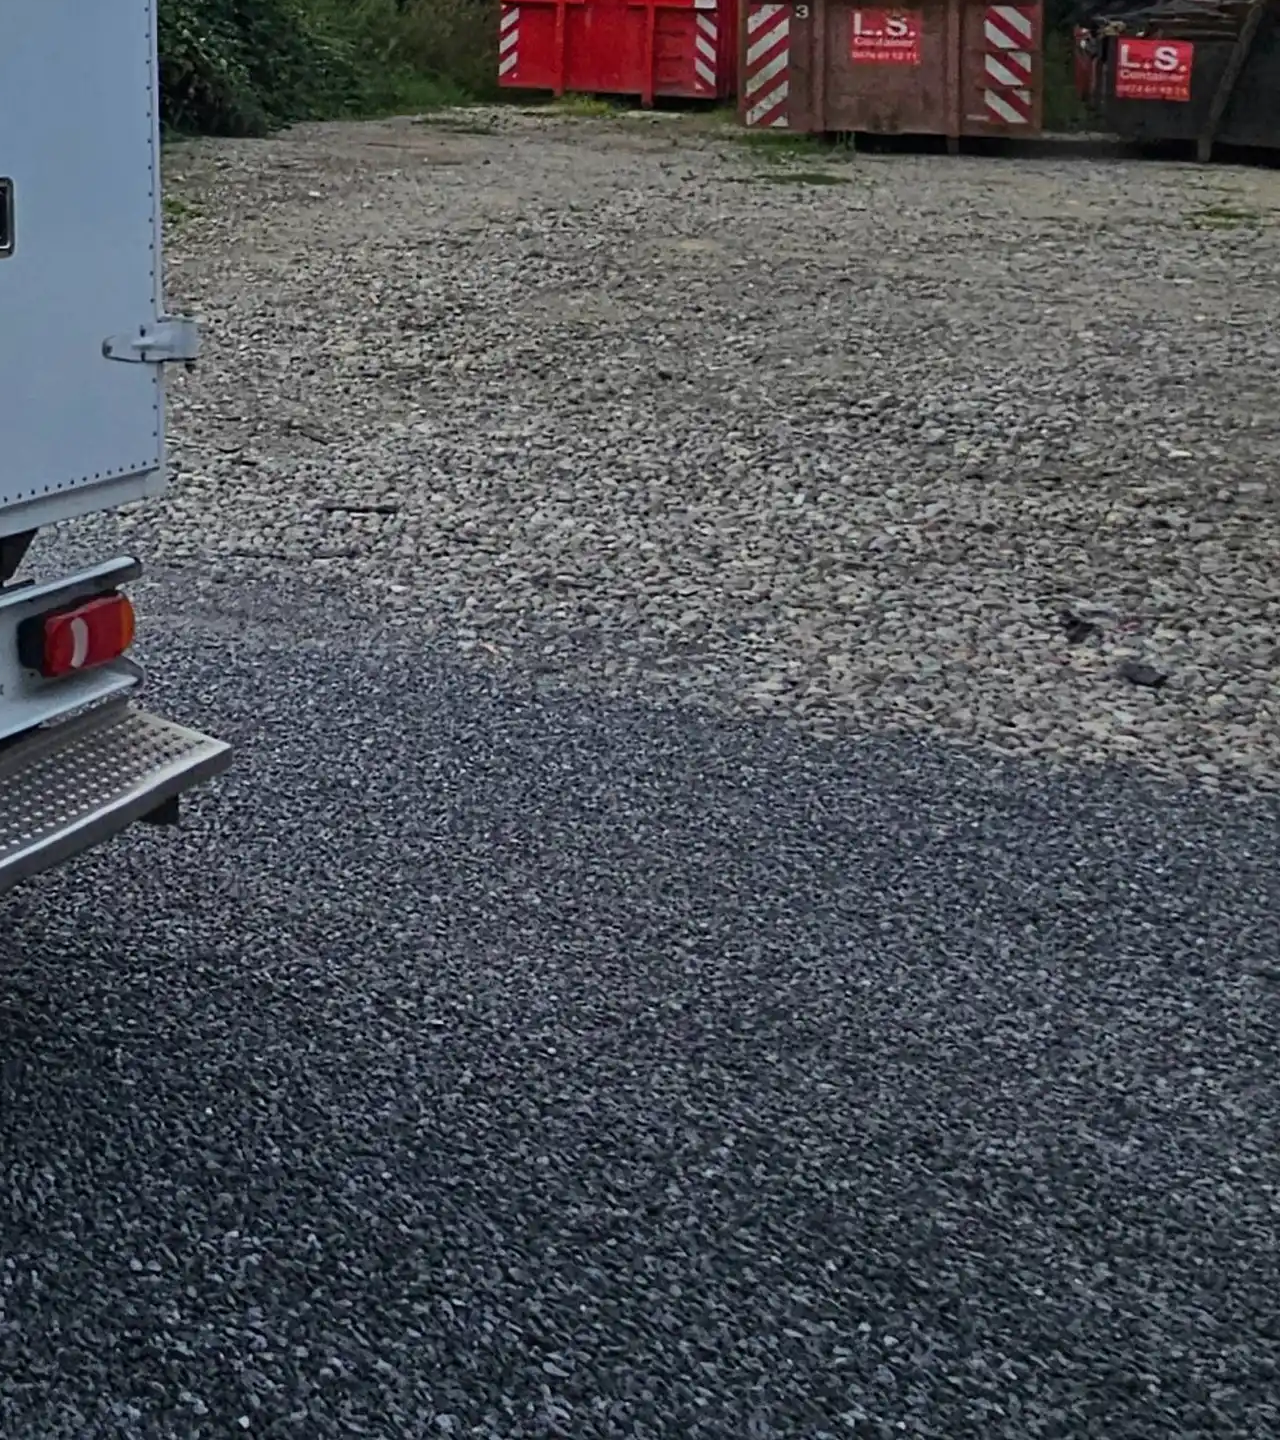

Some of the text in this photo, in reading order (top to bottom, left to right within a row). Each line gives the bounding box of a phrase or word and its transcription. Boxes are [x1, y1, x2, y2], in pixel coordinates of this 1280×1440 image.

[795, 4, 809, 19] 3
[853, 12, 917, 37] L.S.
[1121, 44, 1187, 72] L.S.
